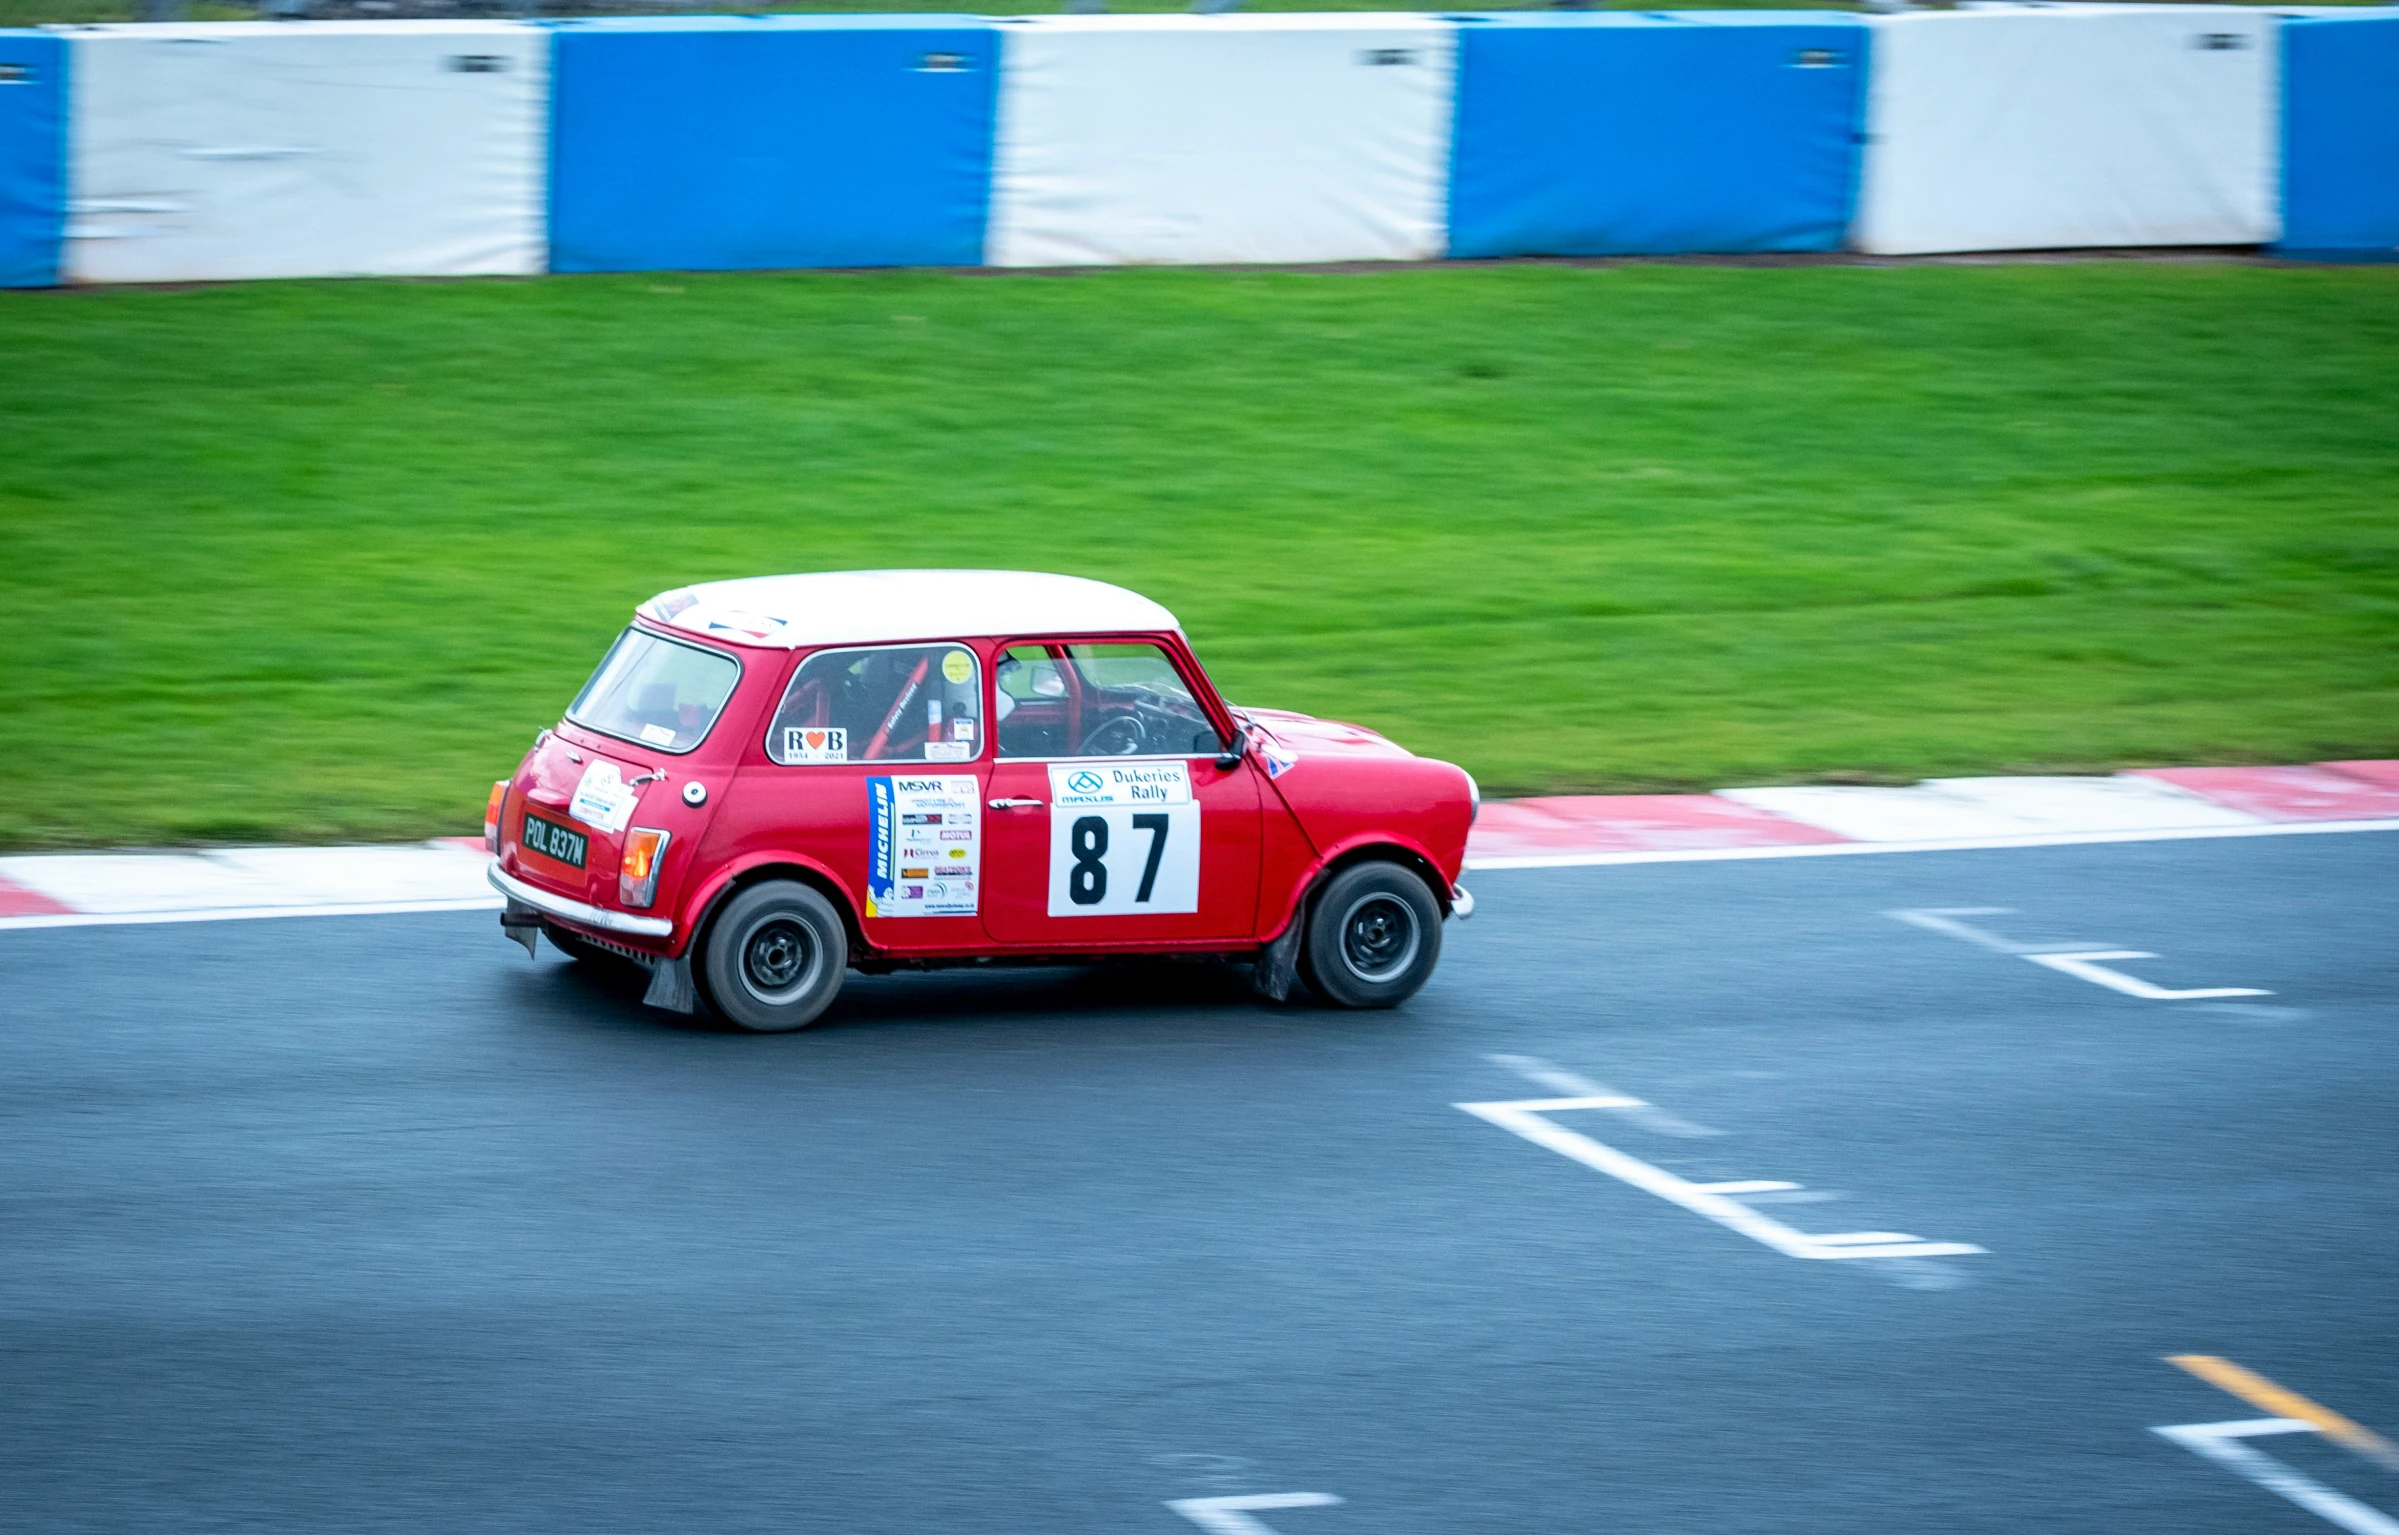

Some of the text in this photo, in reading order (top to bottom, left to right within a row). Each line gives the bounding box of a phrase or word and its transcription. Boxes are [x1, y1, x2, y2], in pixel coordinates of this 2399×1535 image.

[887, 683, 917, 730] Safety Devices
[788, 731, 843, 750] R B
[1113, 769, 1181, 783] Dukeries
[898, 781, 943, 791] MSVR
[1131, 785, 1168, 802] Rally
[1062, 795, 1114, 803] MAXUS
[875, 783, 888, 879] MICHELIN
[525, 818, 584, 865] POL 837N
